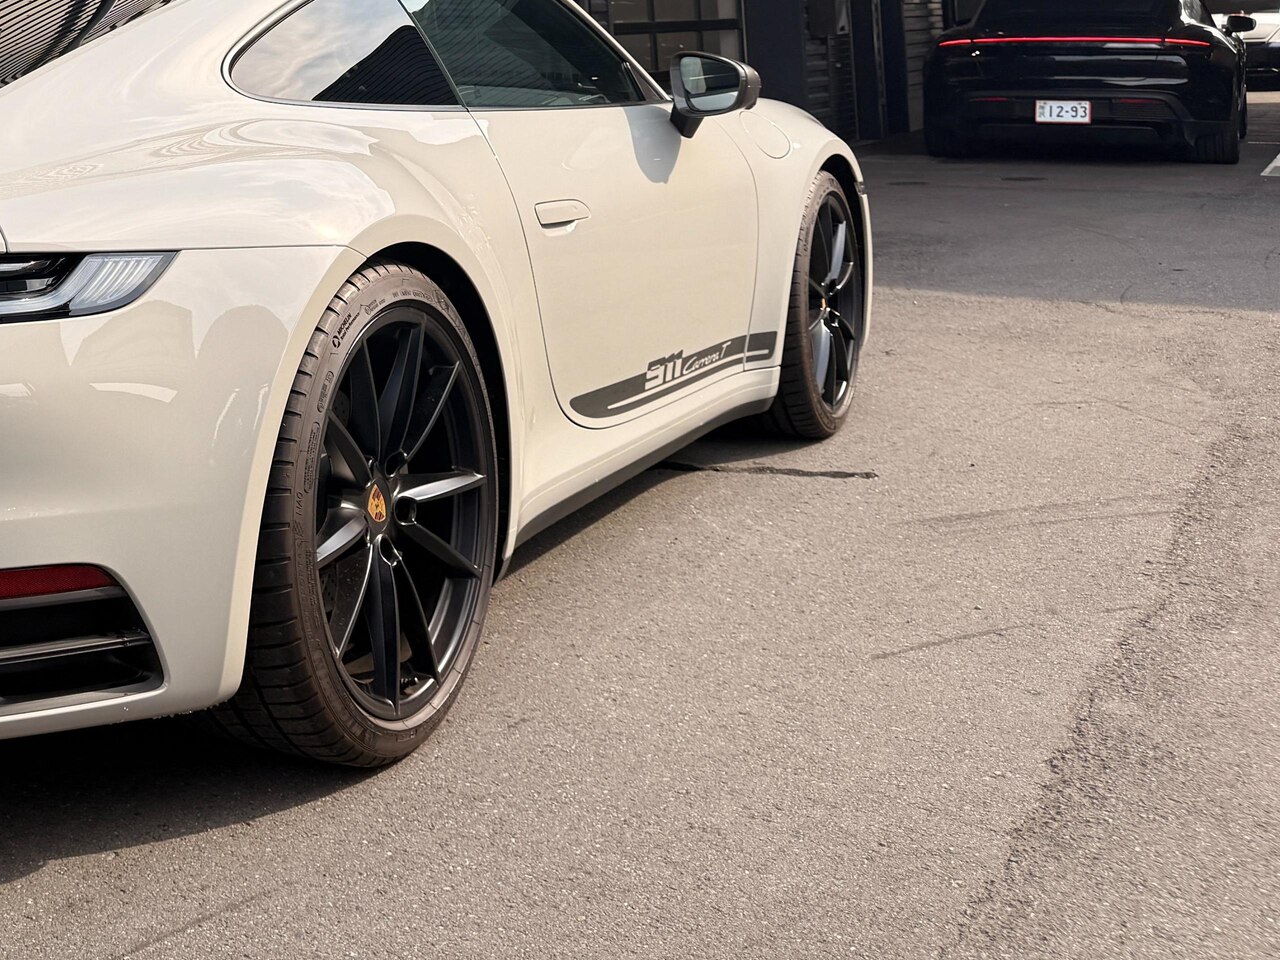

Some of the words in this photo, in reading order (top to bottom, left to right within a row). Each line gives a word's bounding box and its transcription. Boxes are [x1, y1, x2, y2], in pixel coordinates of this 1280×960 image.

[1049, 105, 1088, 118] 12-93
[644, 354, 683, 390] 911
[682, 351, 720, 375] Carrera
[720, 340, 732, 358] T
